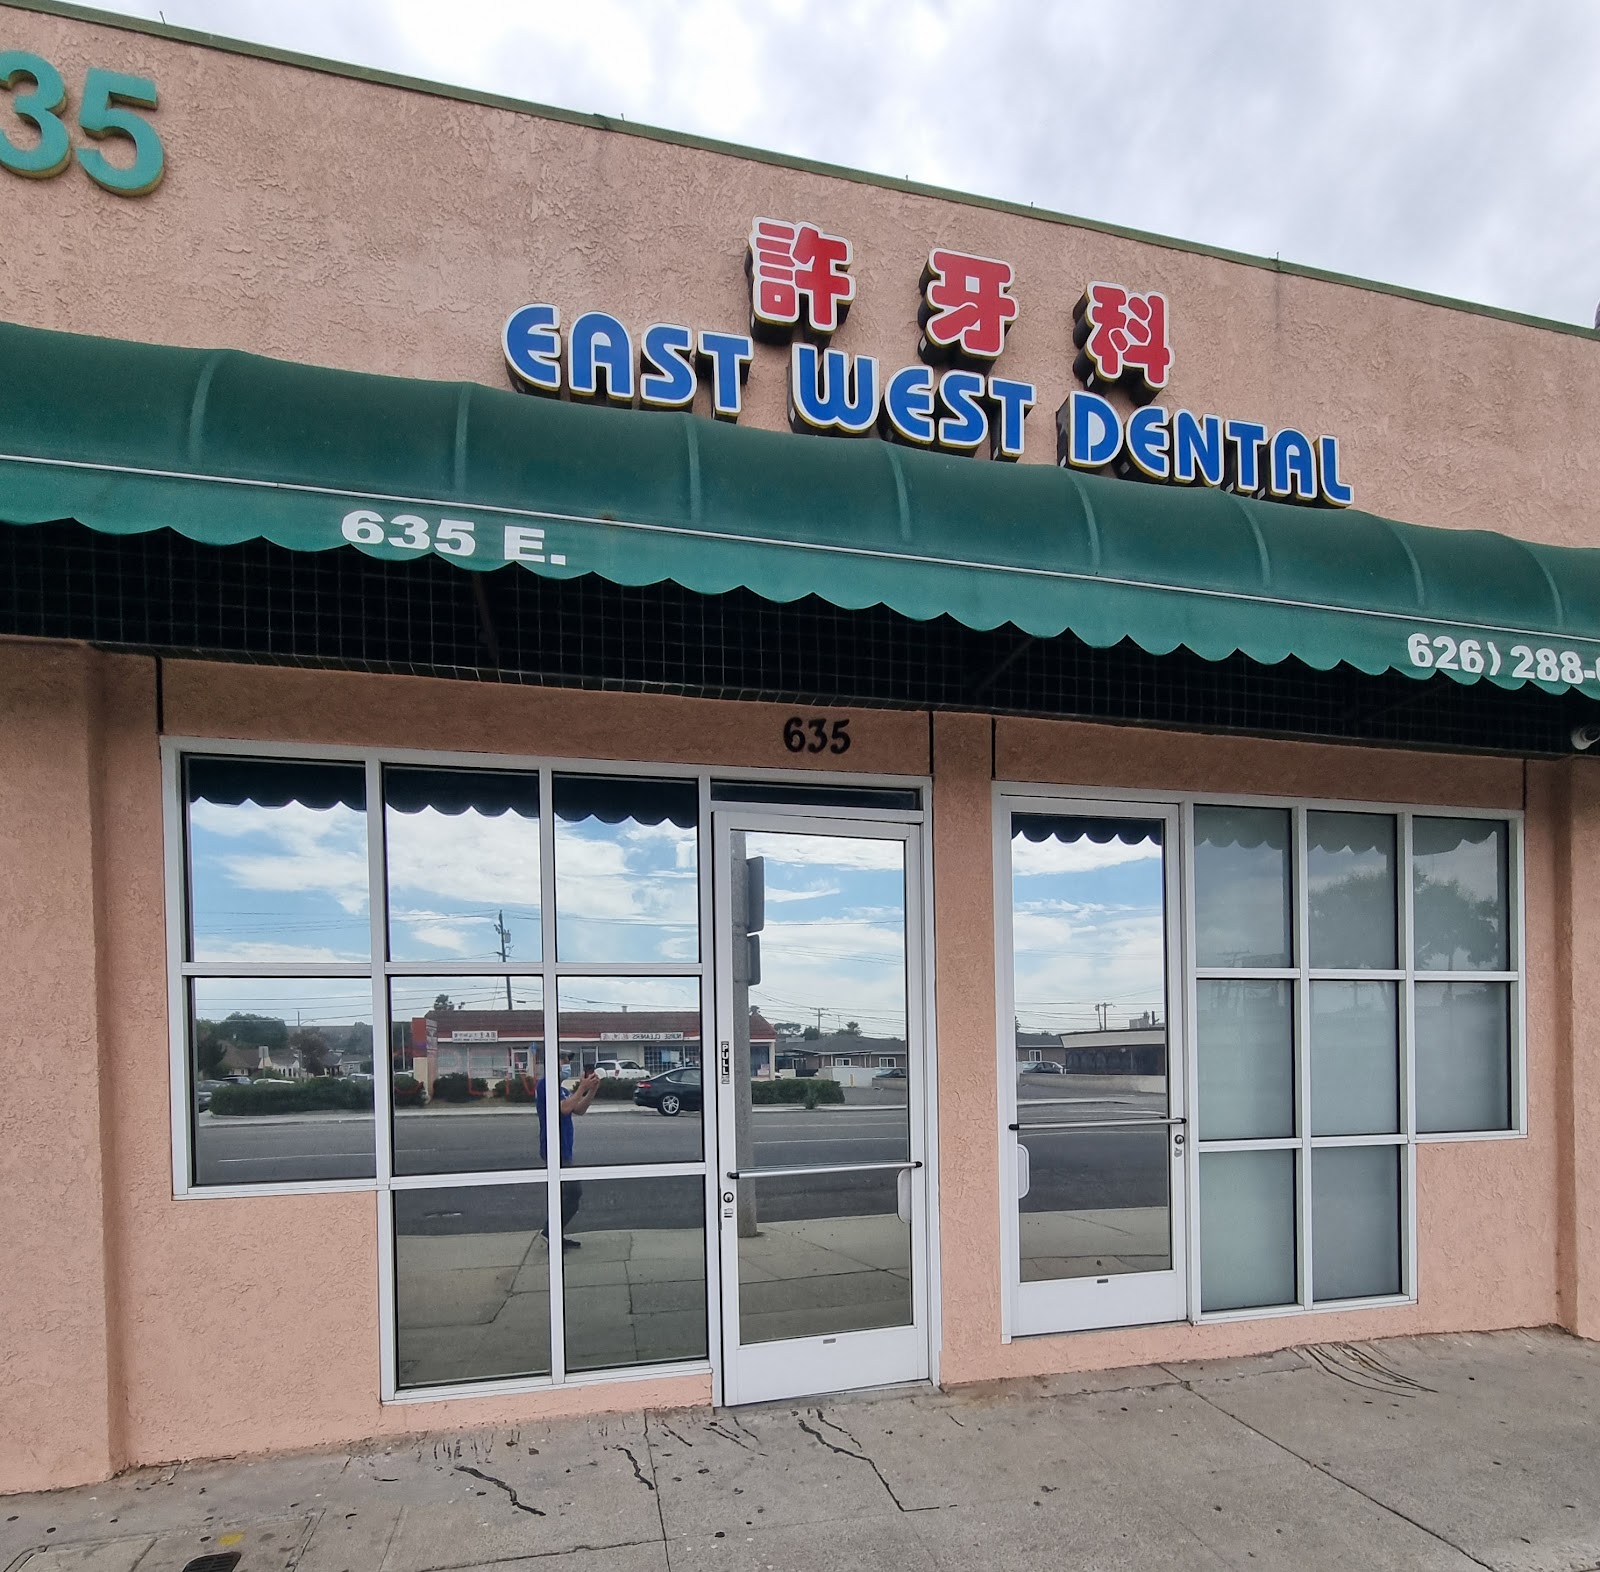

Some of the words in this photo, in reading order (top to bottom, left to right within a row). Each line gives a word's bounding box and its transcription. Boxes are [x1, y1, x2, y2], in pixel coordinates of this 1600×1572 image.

[748, 215, 1176, 389] 許牙科
[501, 302, 754, 414] EAST
[791, 341, 1037, 456] WEST
[1069, 390, 1355, 509] DENTAL
[341, 510, 476, 557] 635
[504, 525, 567, 566] E.
[1407, 632, 1502, 677] 626)
[1510, 645, 1600, 685] 288-
[783, 717, 851, 754] 635
[722, 1044, 730, 1075] PULL
